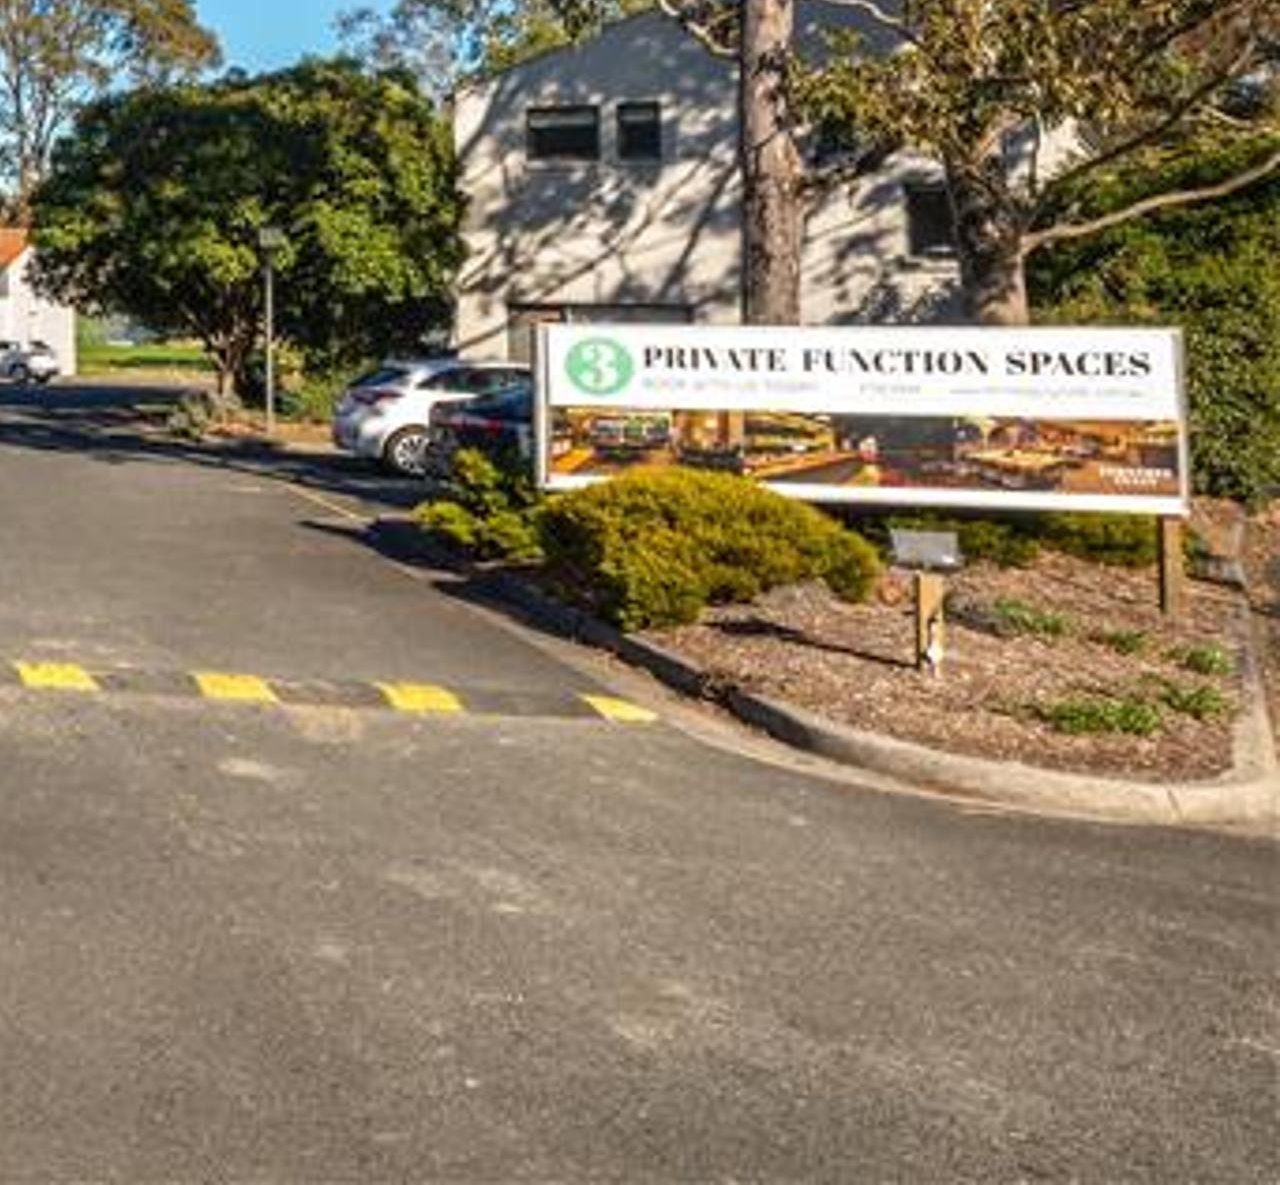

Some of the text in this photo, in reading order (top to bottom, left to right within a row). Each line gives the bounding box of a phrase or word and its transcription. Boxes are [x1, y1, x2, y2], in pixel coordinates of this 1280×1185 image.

[580, 343, 618, 393] 3
[643, 346, 1151, 376] PRIVATE FUNCTION SPACES
